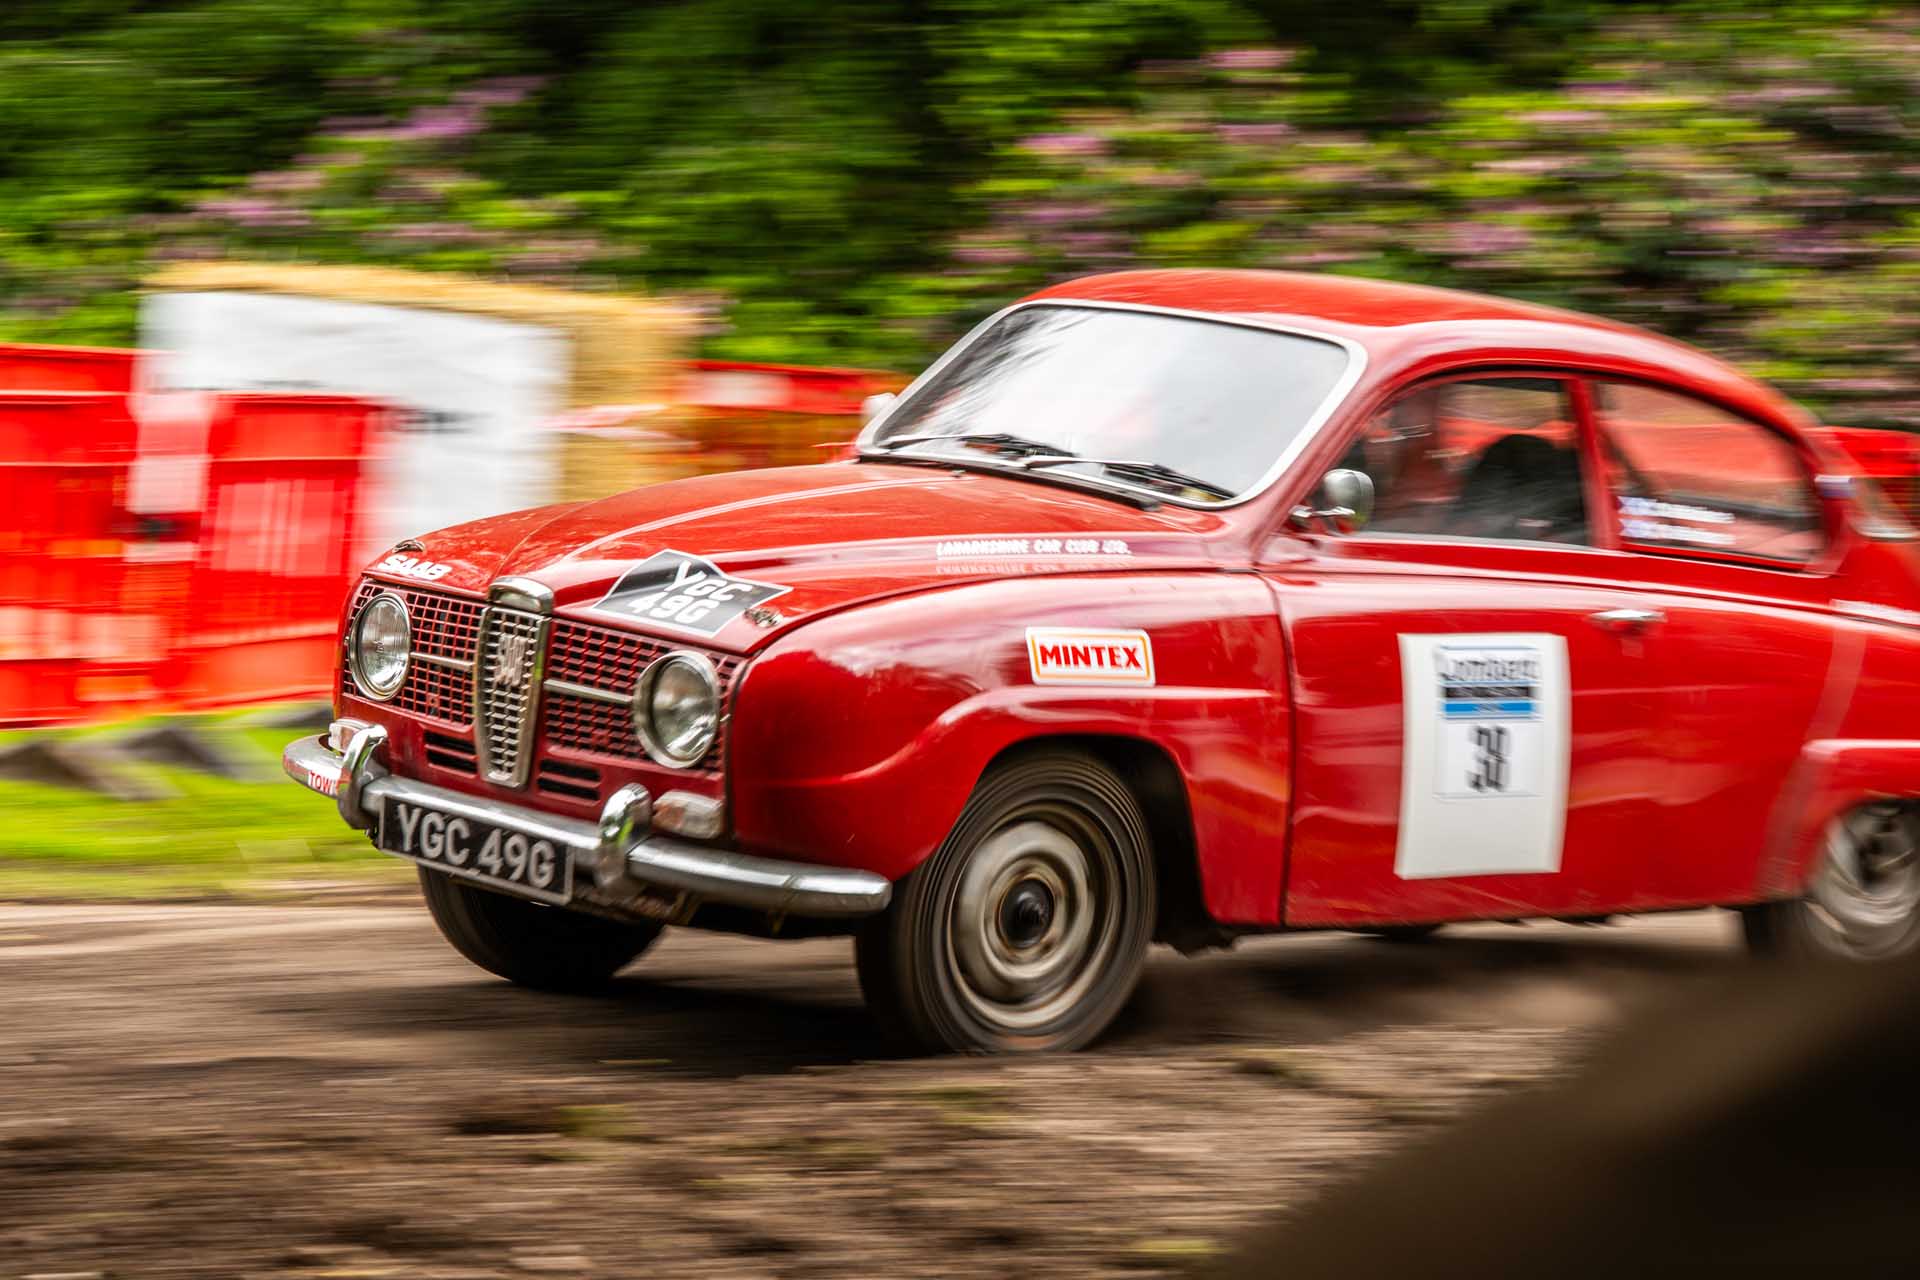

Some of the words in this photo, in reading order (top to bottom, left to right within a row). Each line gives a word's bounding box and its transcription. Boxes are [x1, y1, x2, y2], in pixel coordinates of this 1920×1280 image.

[377, 554, 453, 580] SAAB
[664, 560, 753, 601] YGC
[627, 591, 720, 624] 49G
[1039, 644, 1142, 669] MINTEX
[398, 803, 470, 865] YGC
[478, 829, 555, 889] 49G
